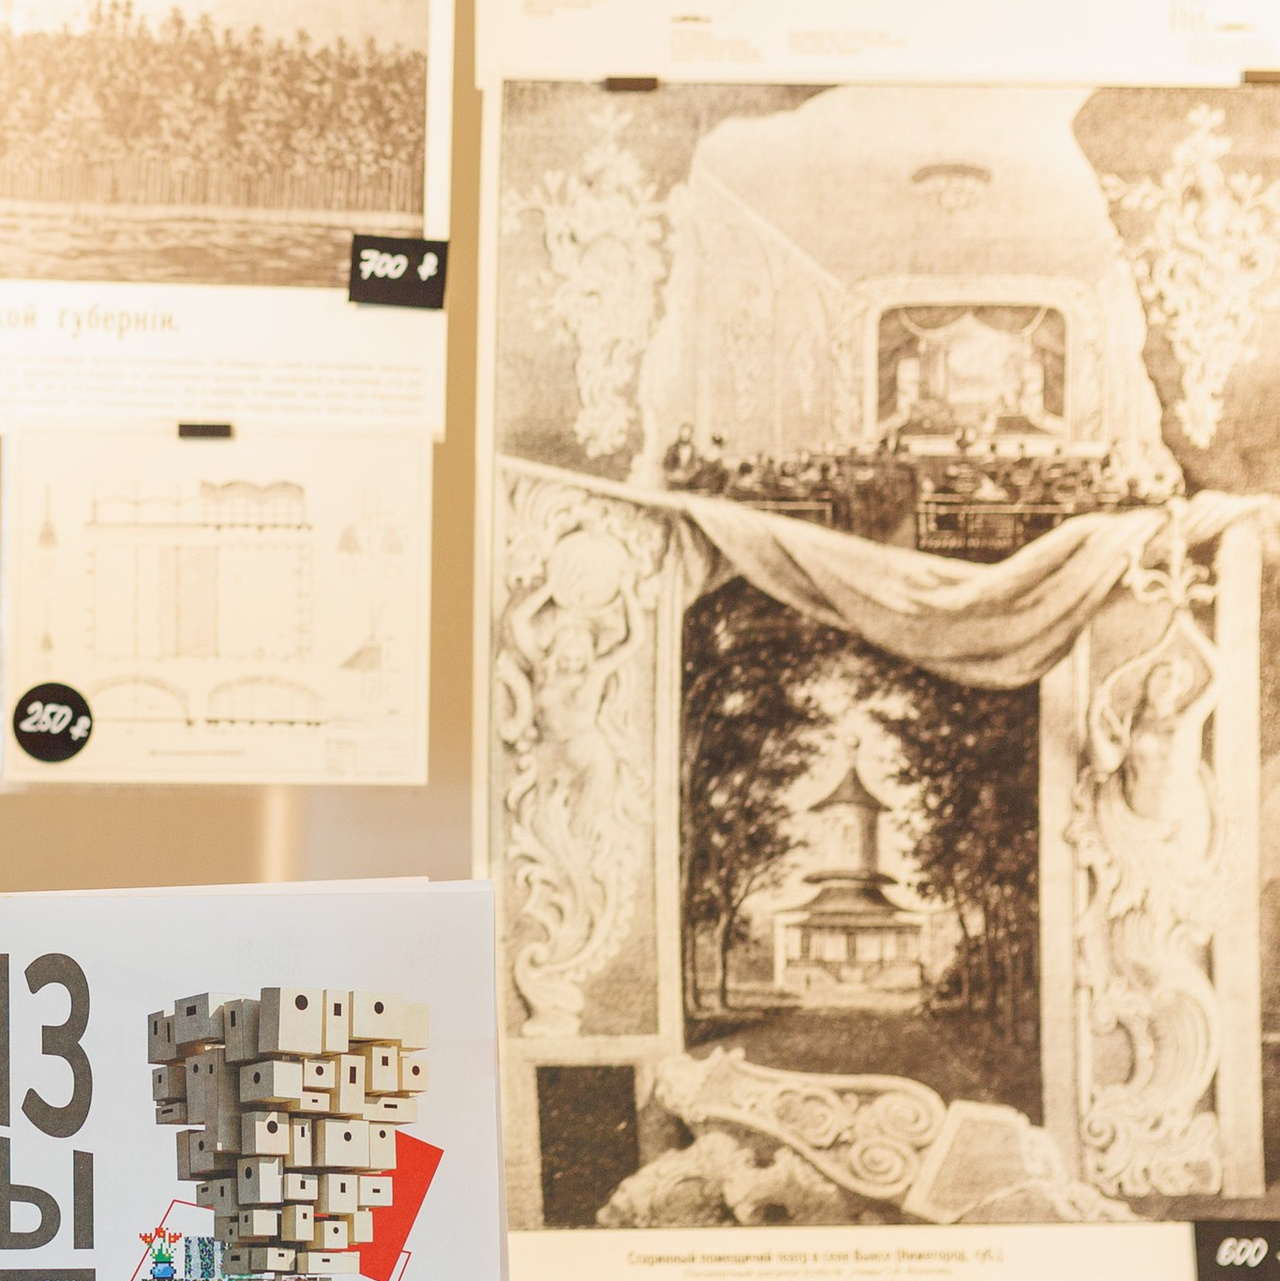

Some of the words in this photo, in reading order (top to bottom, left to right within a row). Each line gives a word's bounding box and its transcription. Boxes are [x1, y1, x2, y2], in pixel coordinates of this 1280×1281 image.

[359, 248, 409, 280] 700
[19, 701, 72, 734] 250
[1216, 1237, 1269, 1268] 600
